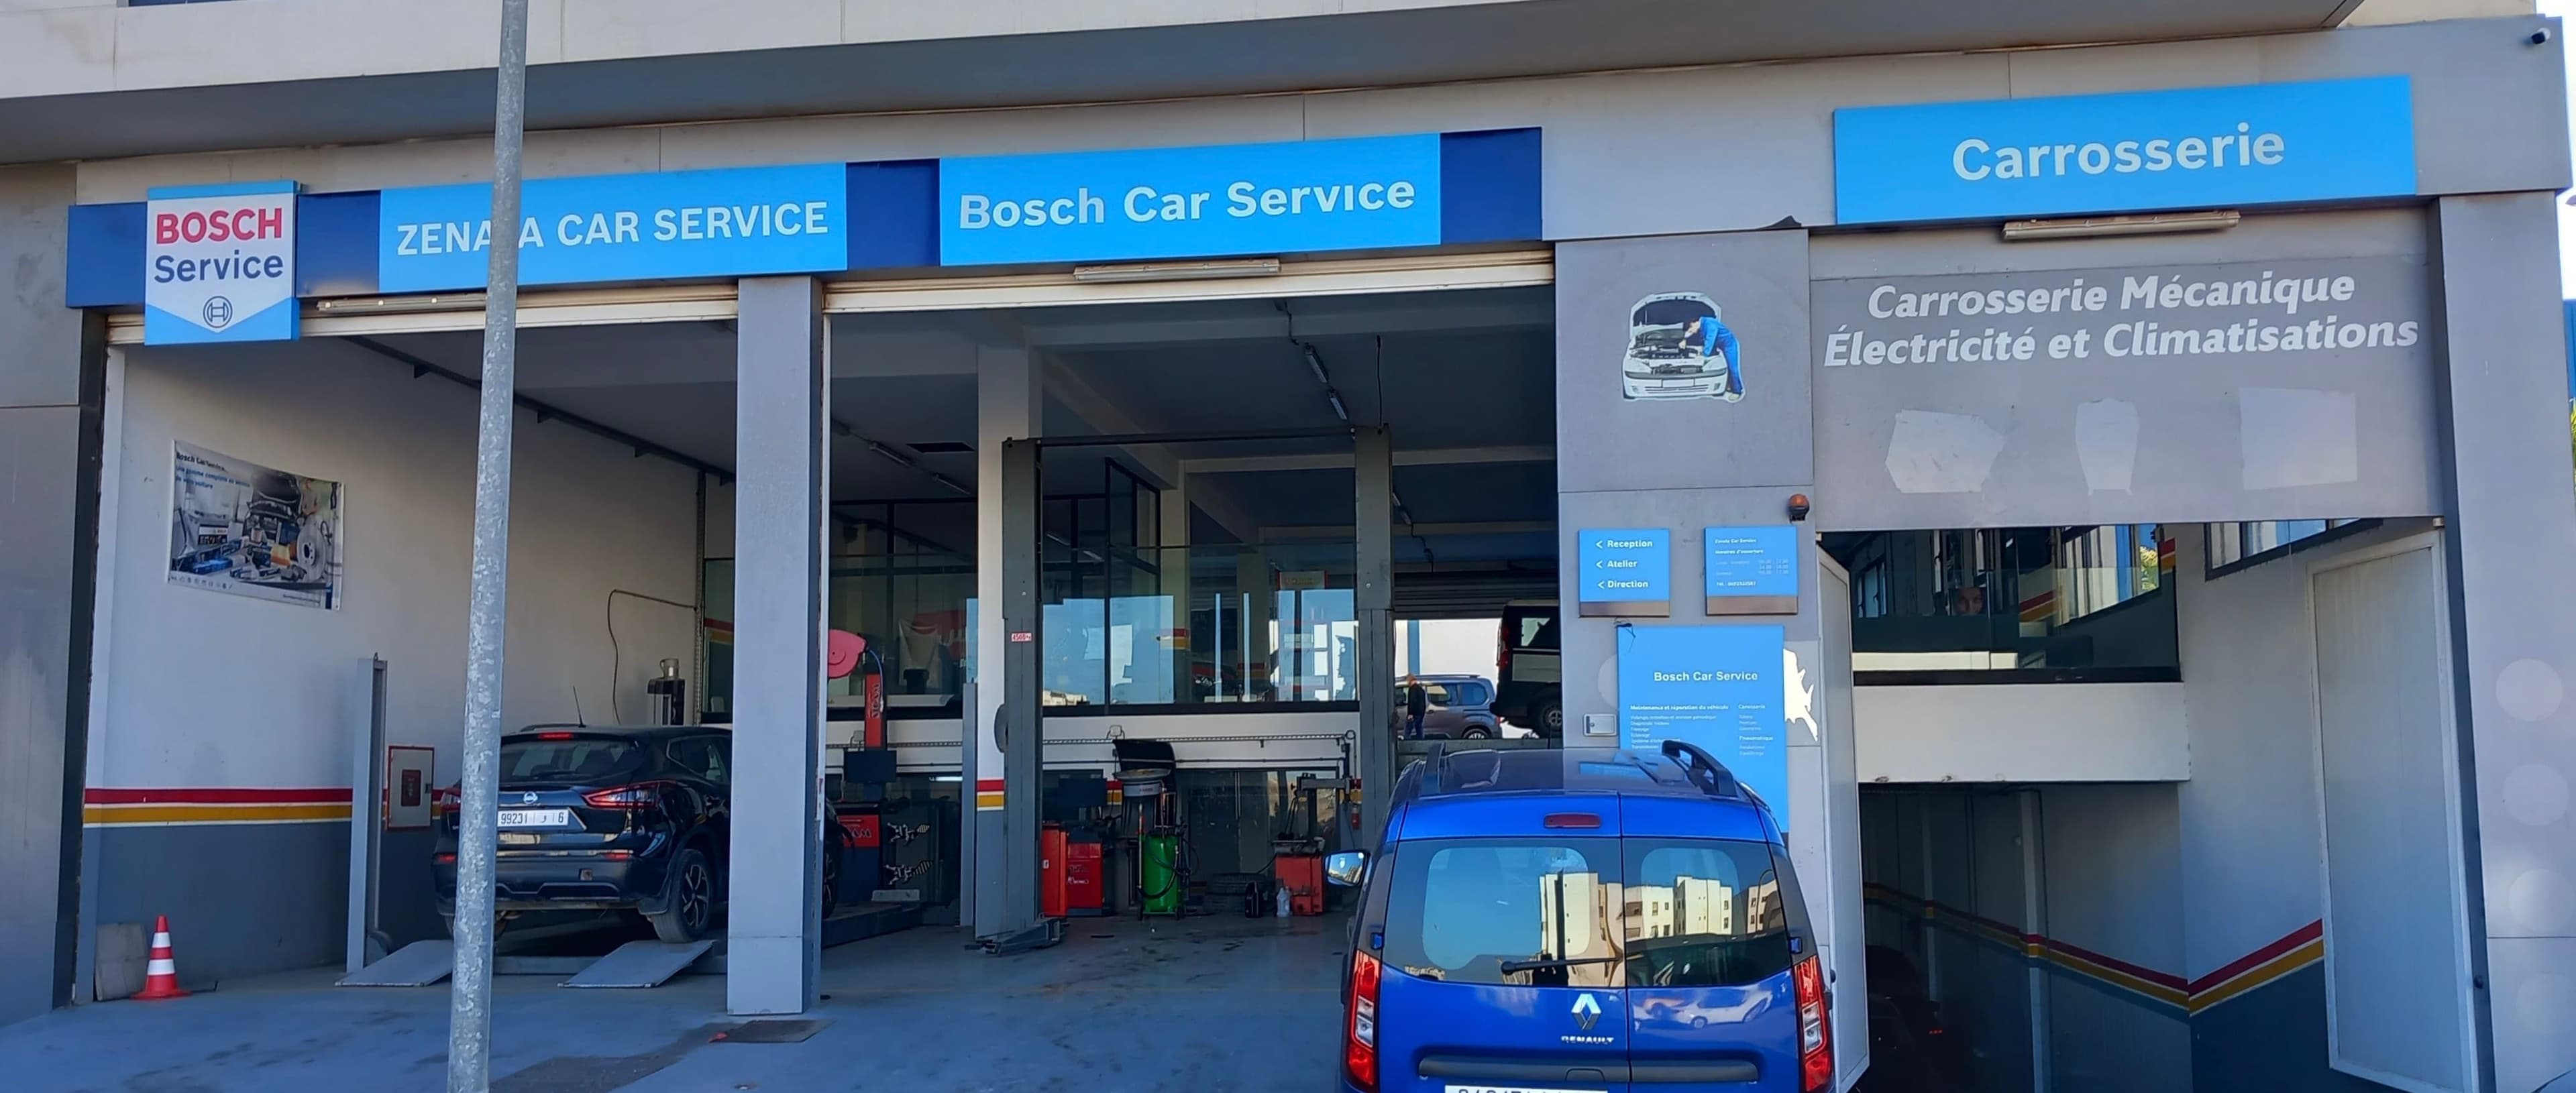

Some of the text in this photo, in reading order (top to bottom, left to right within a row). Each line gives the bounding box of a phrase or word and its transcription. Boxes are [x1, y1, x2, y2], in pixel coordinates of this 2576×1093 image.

[1952, 122, 2285, 181] Carrosserie
[959, 179, 1415, 229] Bosch Car Service
[156, 208, 282, 244] BOSCH
[397, 201, 828, 255] ZENAA CAR SERVICE
[154, 249, 283, 283] Service
[1868, 270, 2355, 319] Carrosserie Mécanique
[1824, 315, 2419, 367] Électricité et Climatisations
[1607, 539, 1653, 550] Reception
[1607, 559, 1638, 568] Atelier
[1607, 579, 1648, 588] Direction
[1654, 671, 1758, 681] Bosch Car Service
[558, 811, 564, 823] 6
[1561, 1035, 1614, 1045] RENAULT
